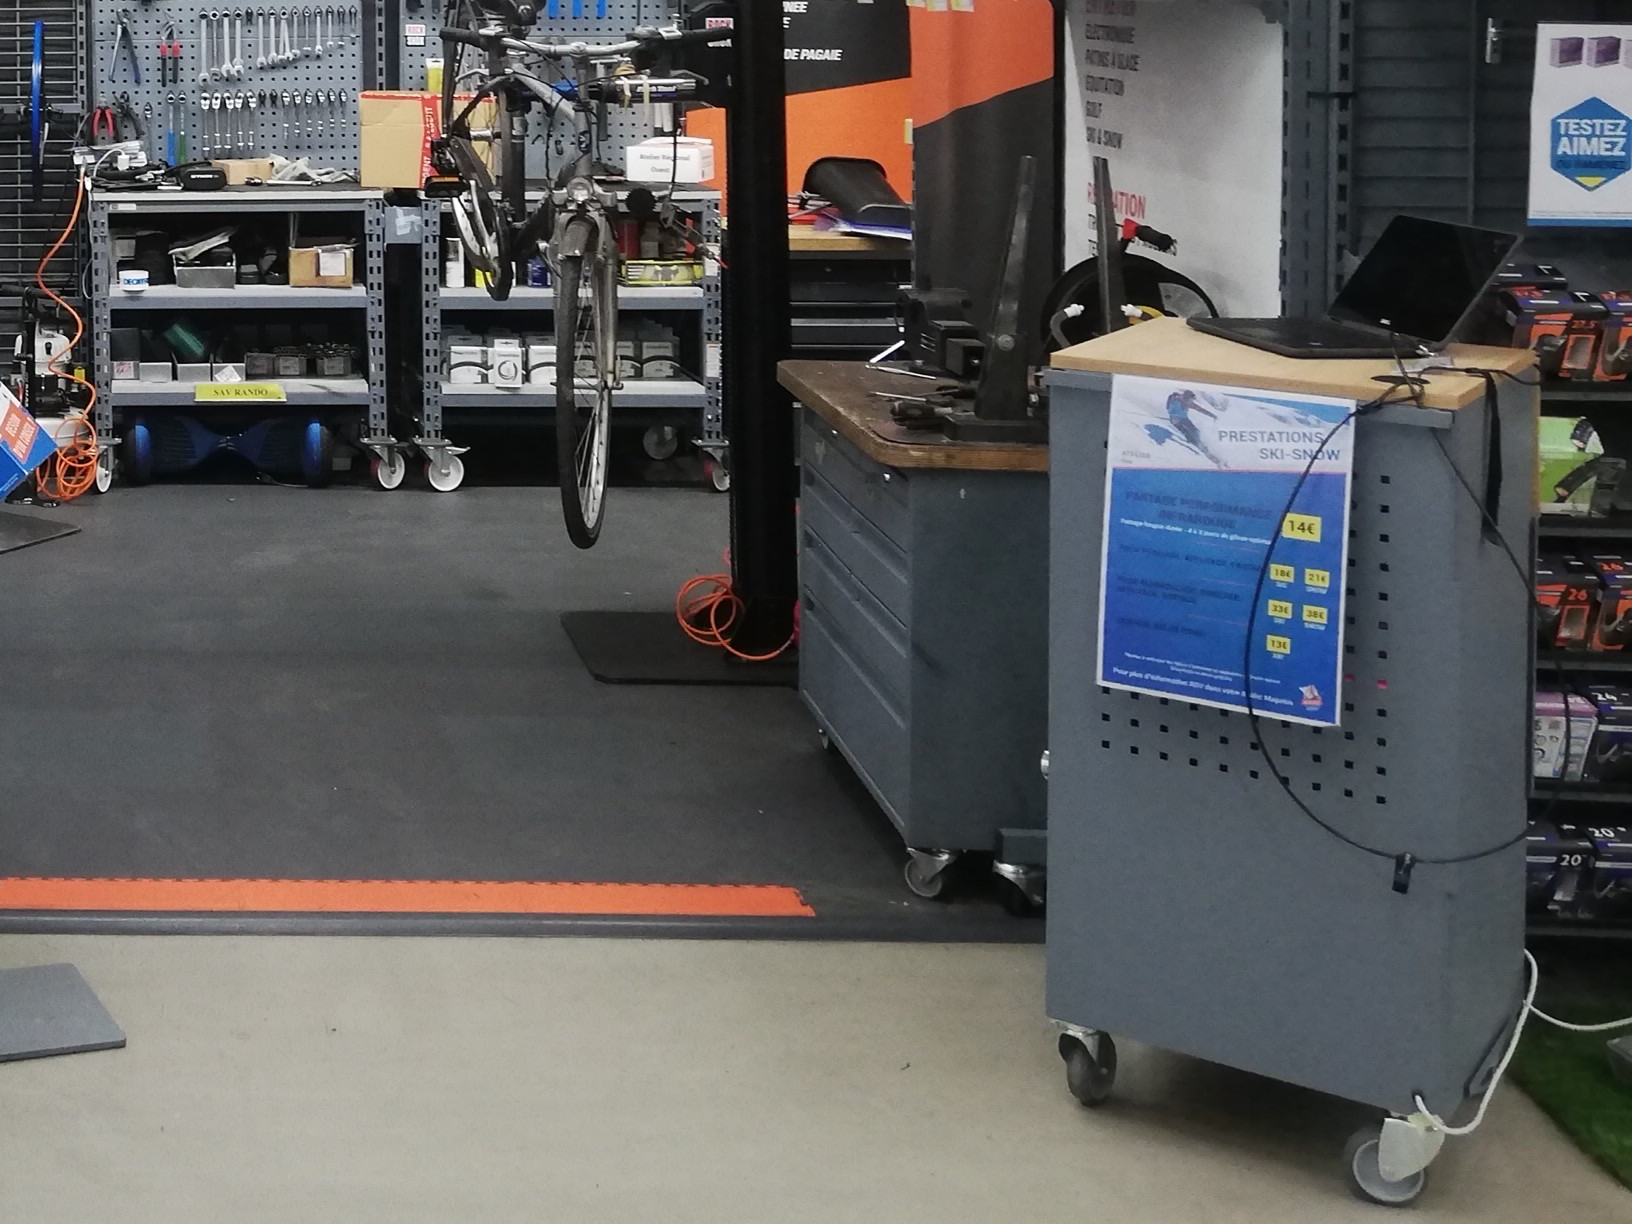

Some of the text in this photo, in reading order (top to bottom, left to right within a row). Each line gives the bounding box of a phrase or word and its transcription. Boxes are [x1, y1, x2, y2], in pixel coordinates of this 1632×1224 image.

[783, 49, 843, 61] DE PAGAIE
[1557, 118, 1628, 136] TESTEZ
[1557, 137, 1627, 157] AIMEZ
[234, 388, 268, 398] RANDO
[1218, 429, 1325, 446] PRESTATIONS
[1259, 447, 1341, 463] SKI-SNOW
[1288, 520, 1315, 536] 14€
